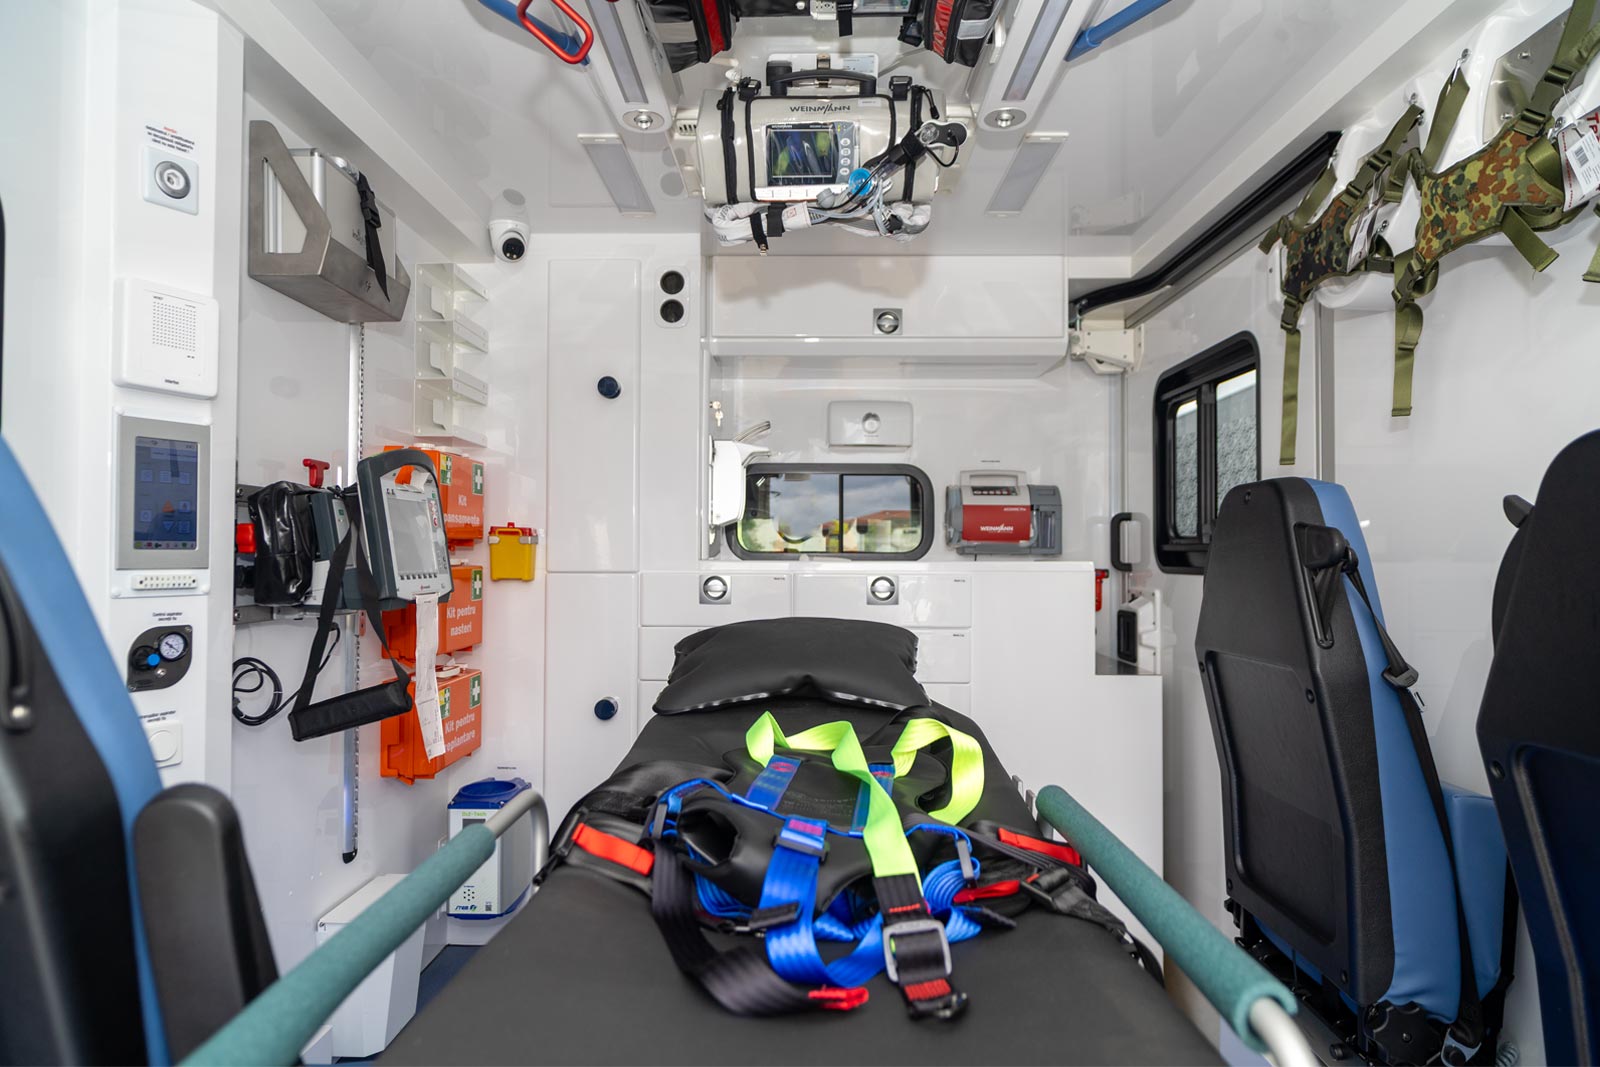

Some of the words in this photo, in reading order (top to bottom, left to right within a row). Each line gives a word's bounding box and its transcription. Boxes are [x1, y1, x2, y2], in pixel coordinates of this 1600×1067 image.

[789, 103, 851, 114] WEINMANN
[457, 494, 468, 507] Kit
[446, 606, 456, 619] Kit
[456, 604, 476, 620] pentru
[450, 621, 472, 637] nasteri
[444, 720, 455, 735] Kit
[455, 711, 476, 732] pentru
